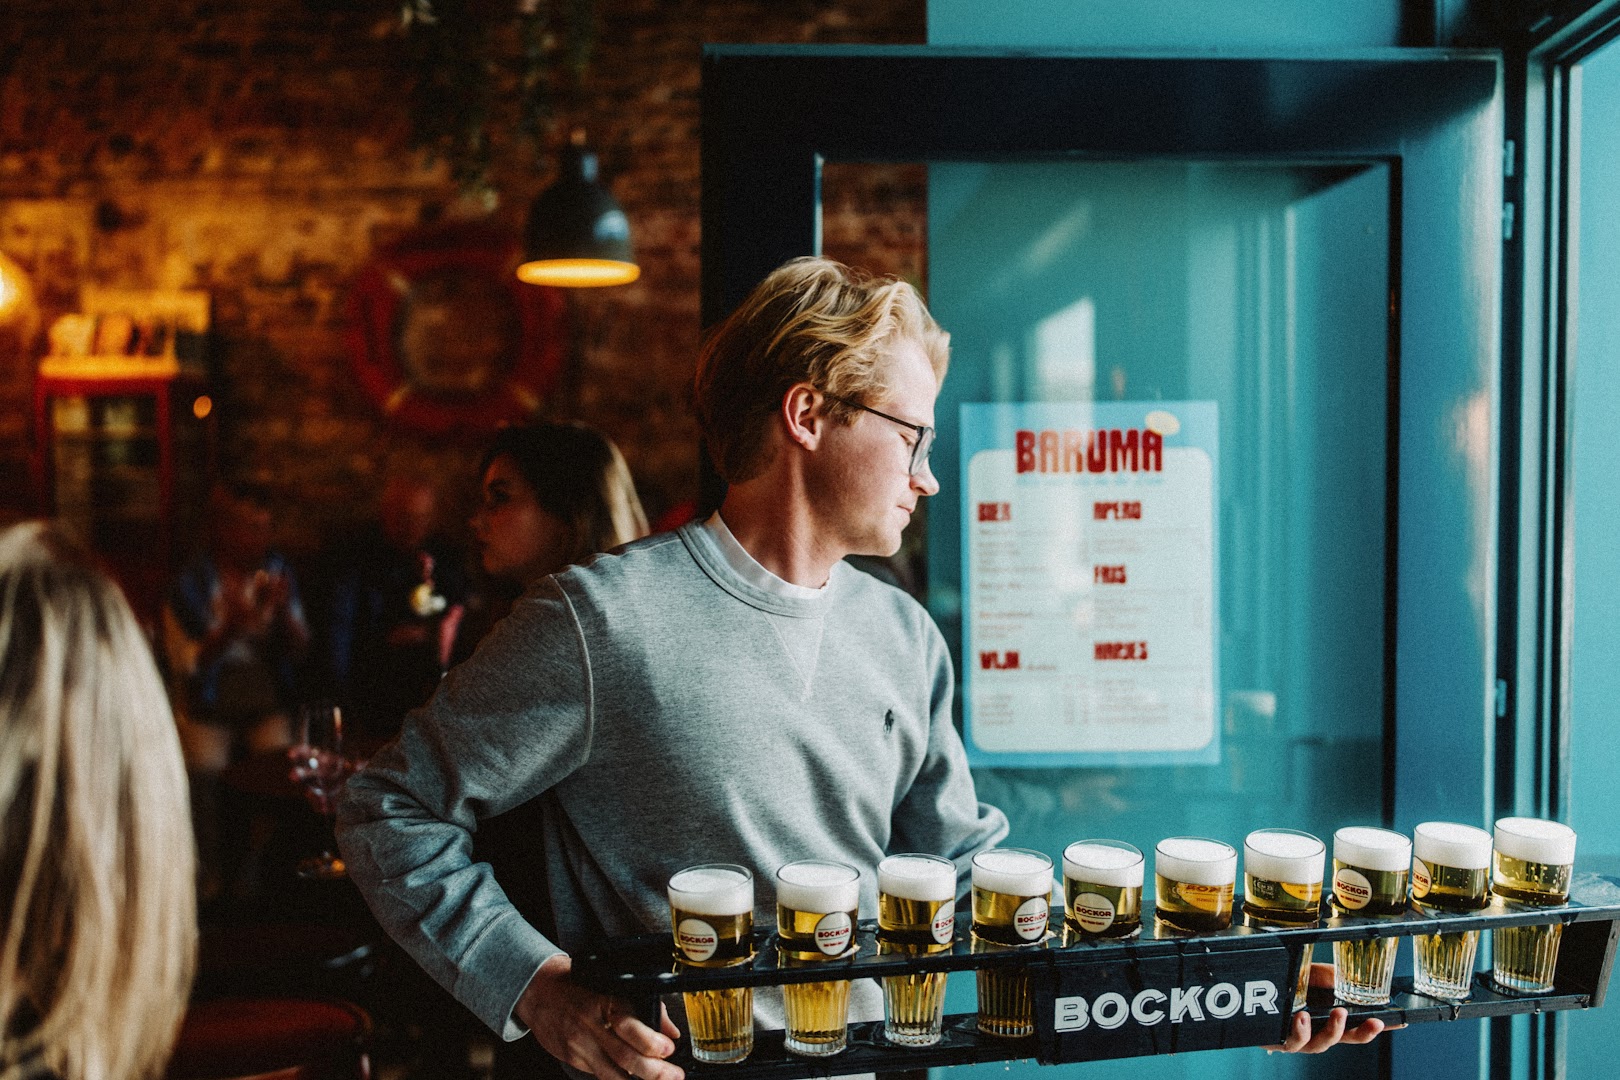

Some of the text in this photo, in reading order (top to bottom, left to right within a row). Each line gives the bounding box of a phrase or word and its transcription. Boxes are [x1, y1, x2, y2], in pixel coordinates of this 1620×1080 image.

[1016, 429, 1163, 474] BARUMA
[1336, 881, 1369, 896] BOCKOR
[1076, 906, 1112, 917] BOCKOR
[1017, 912, 1047, 923] BOCKOR
[817, 927, 849, 938] BOCKOR
[680, 934, 714, 944] BOCKOR
[1053, 979, 1280, 1033] BOCKOR
